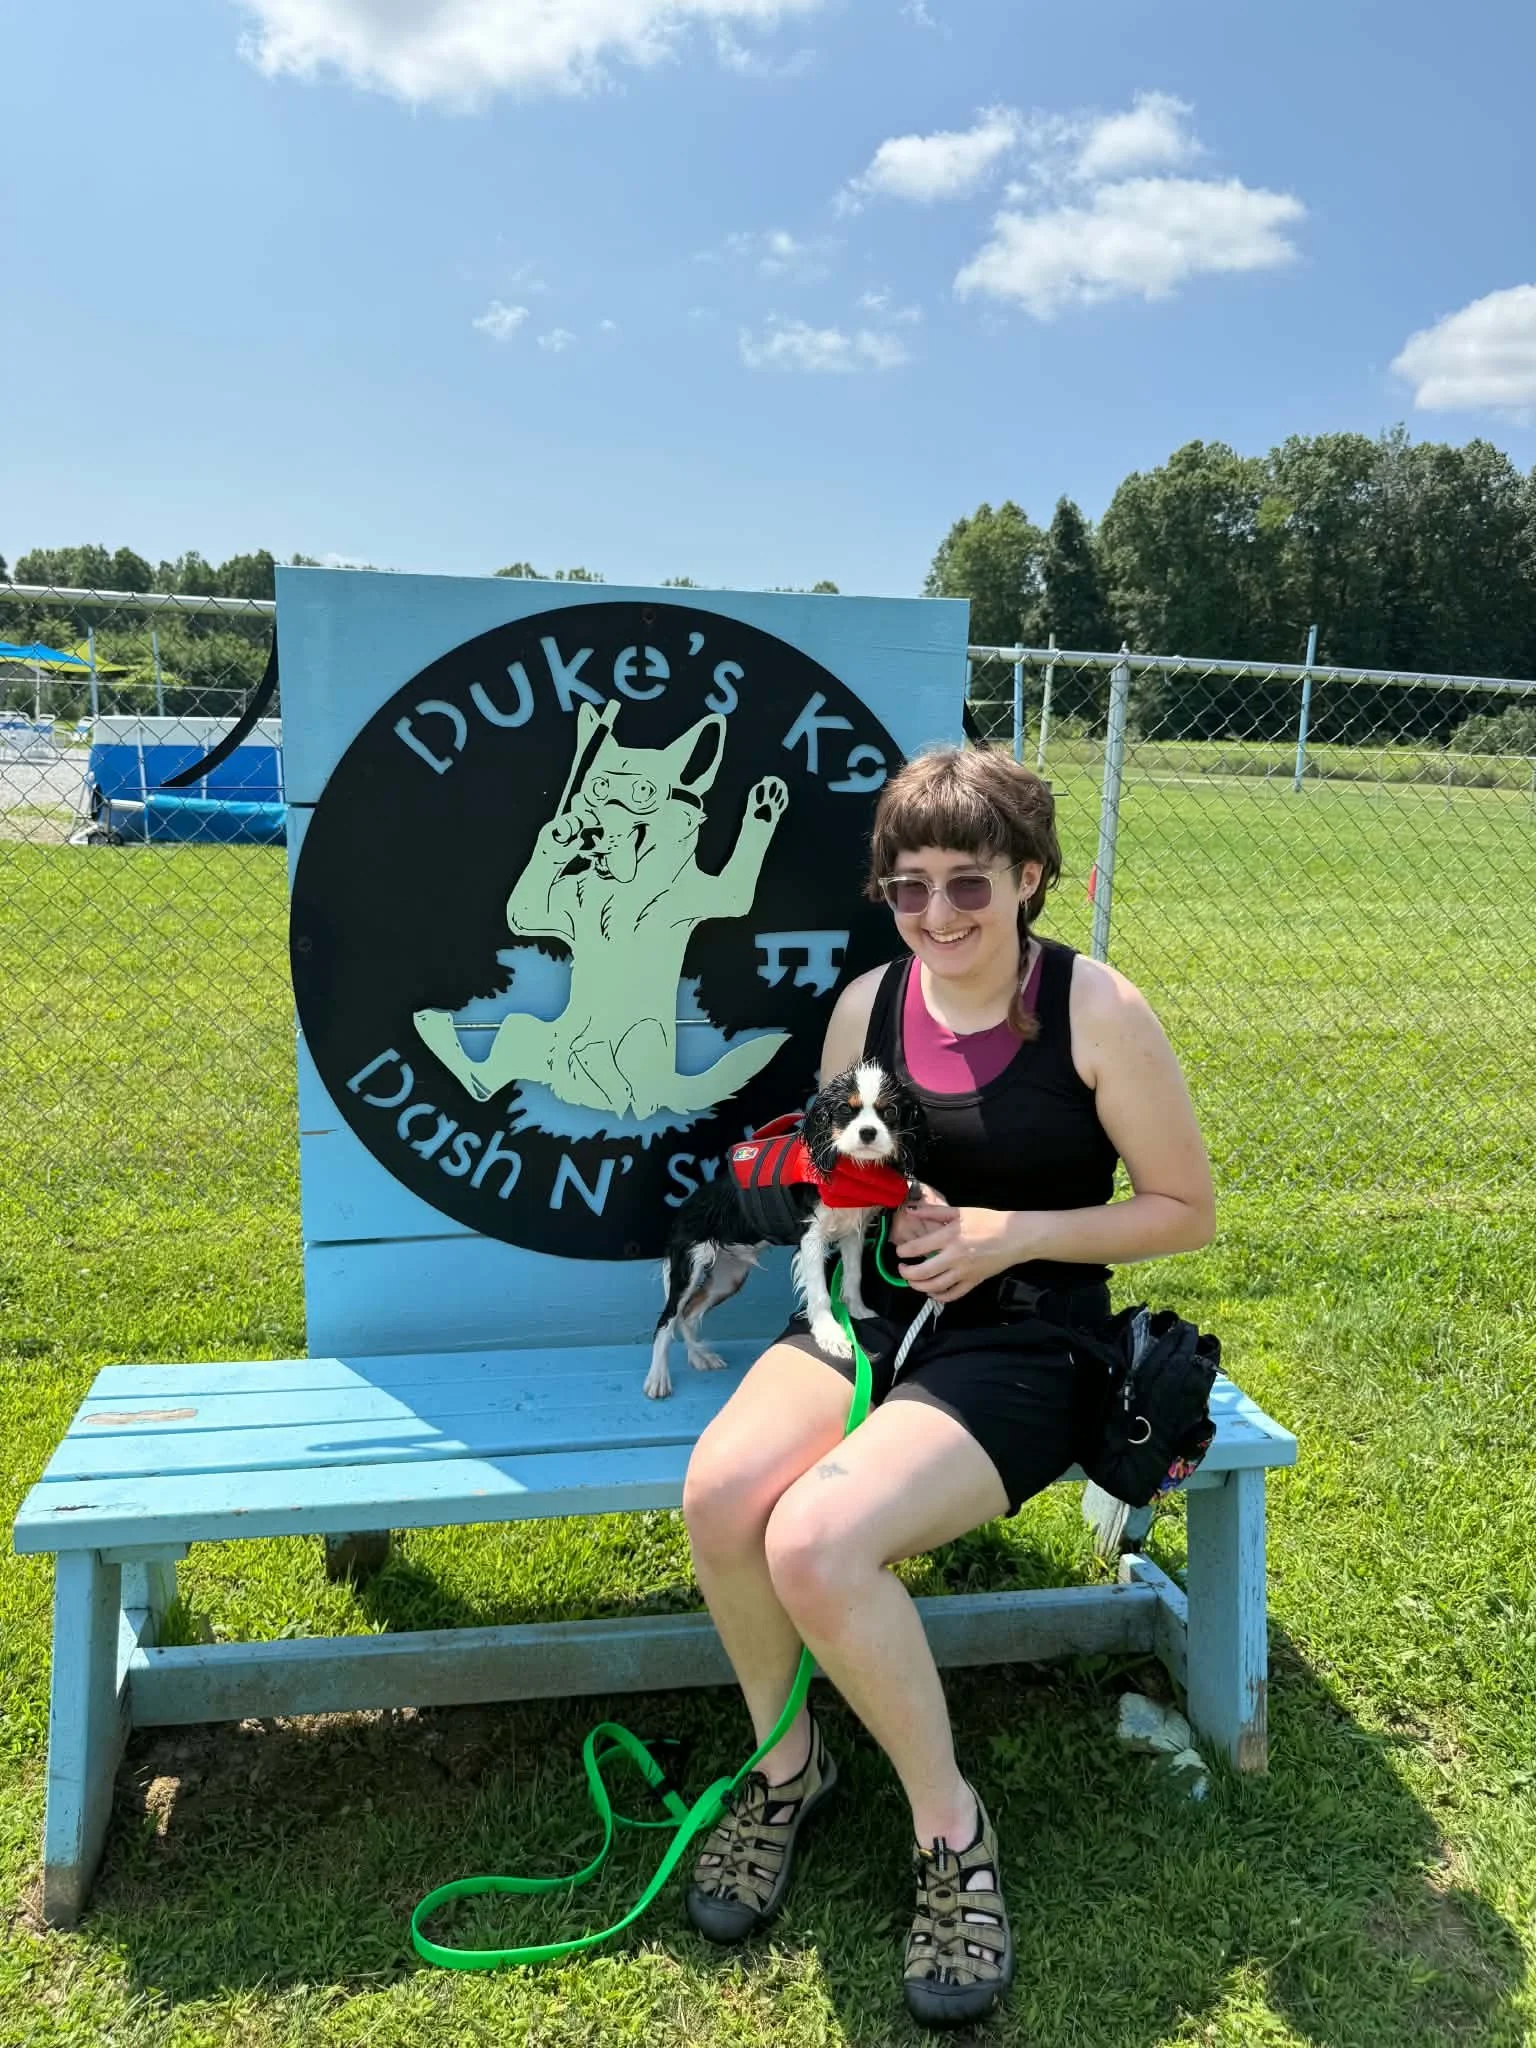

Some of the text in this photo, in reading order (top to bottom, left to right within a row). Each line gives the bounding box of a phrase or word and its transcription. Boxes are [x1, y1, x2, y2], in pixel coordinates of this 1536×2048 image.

[781, 690, 888, 793] K9
[346, 1047, 634, 1217] Dash N'
